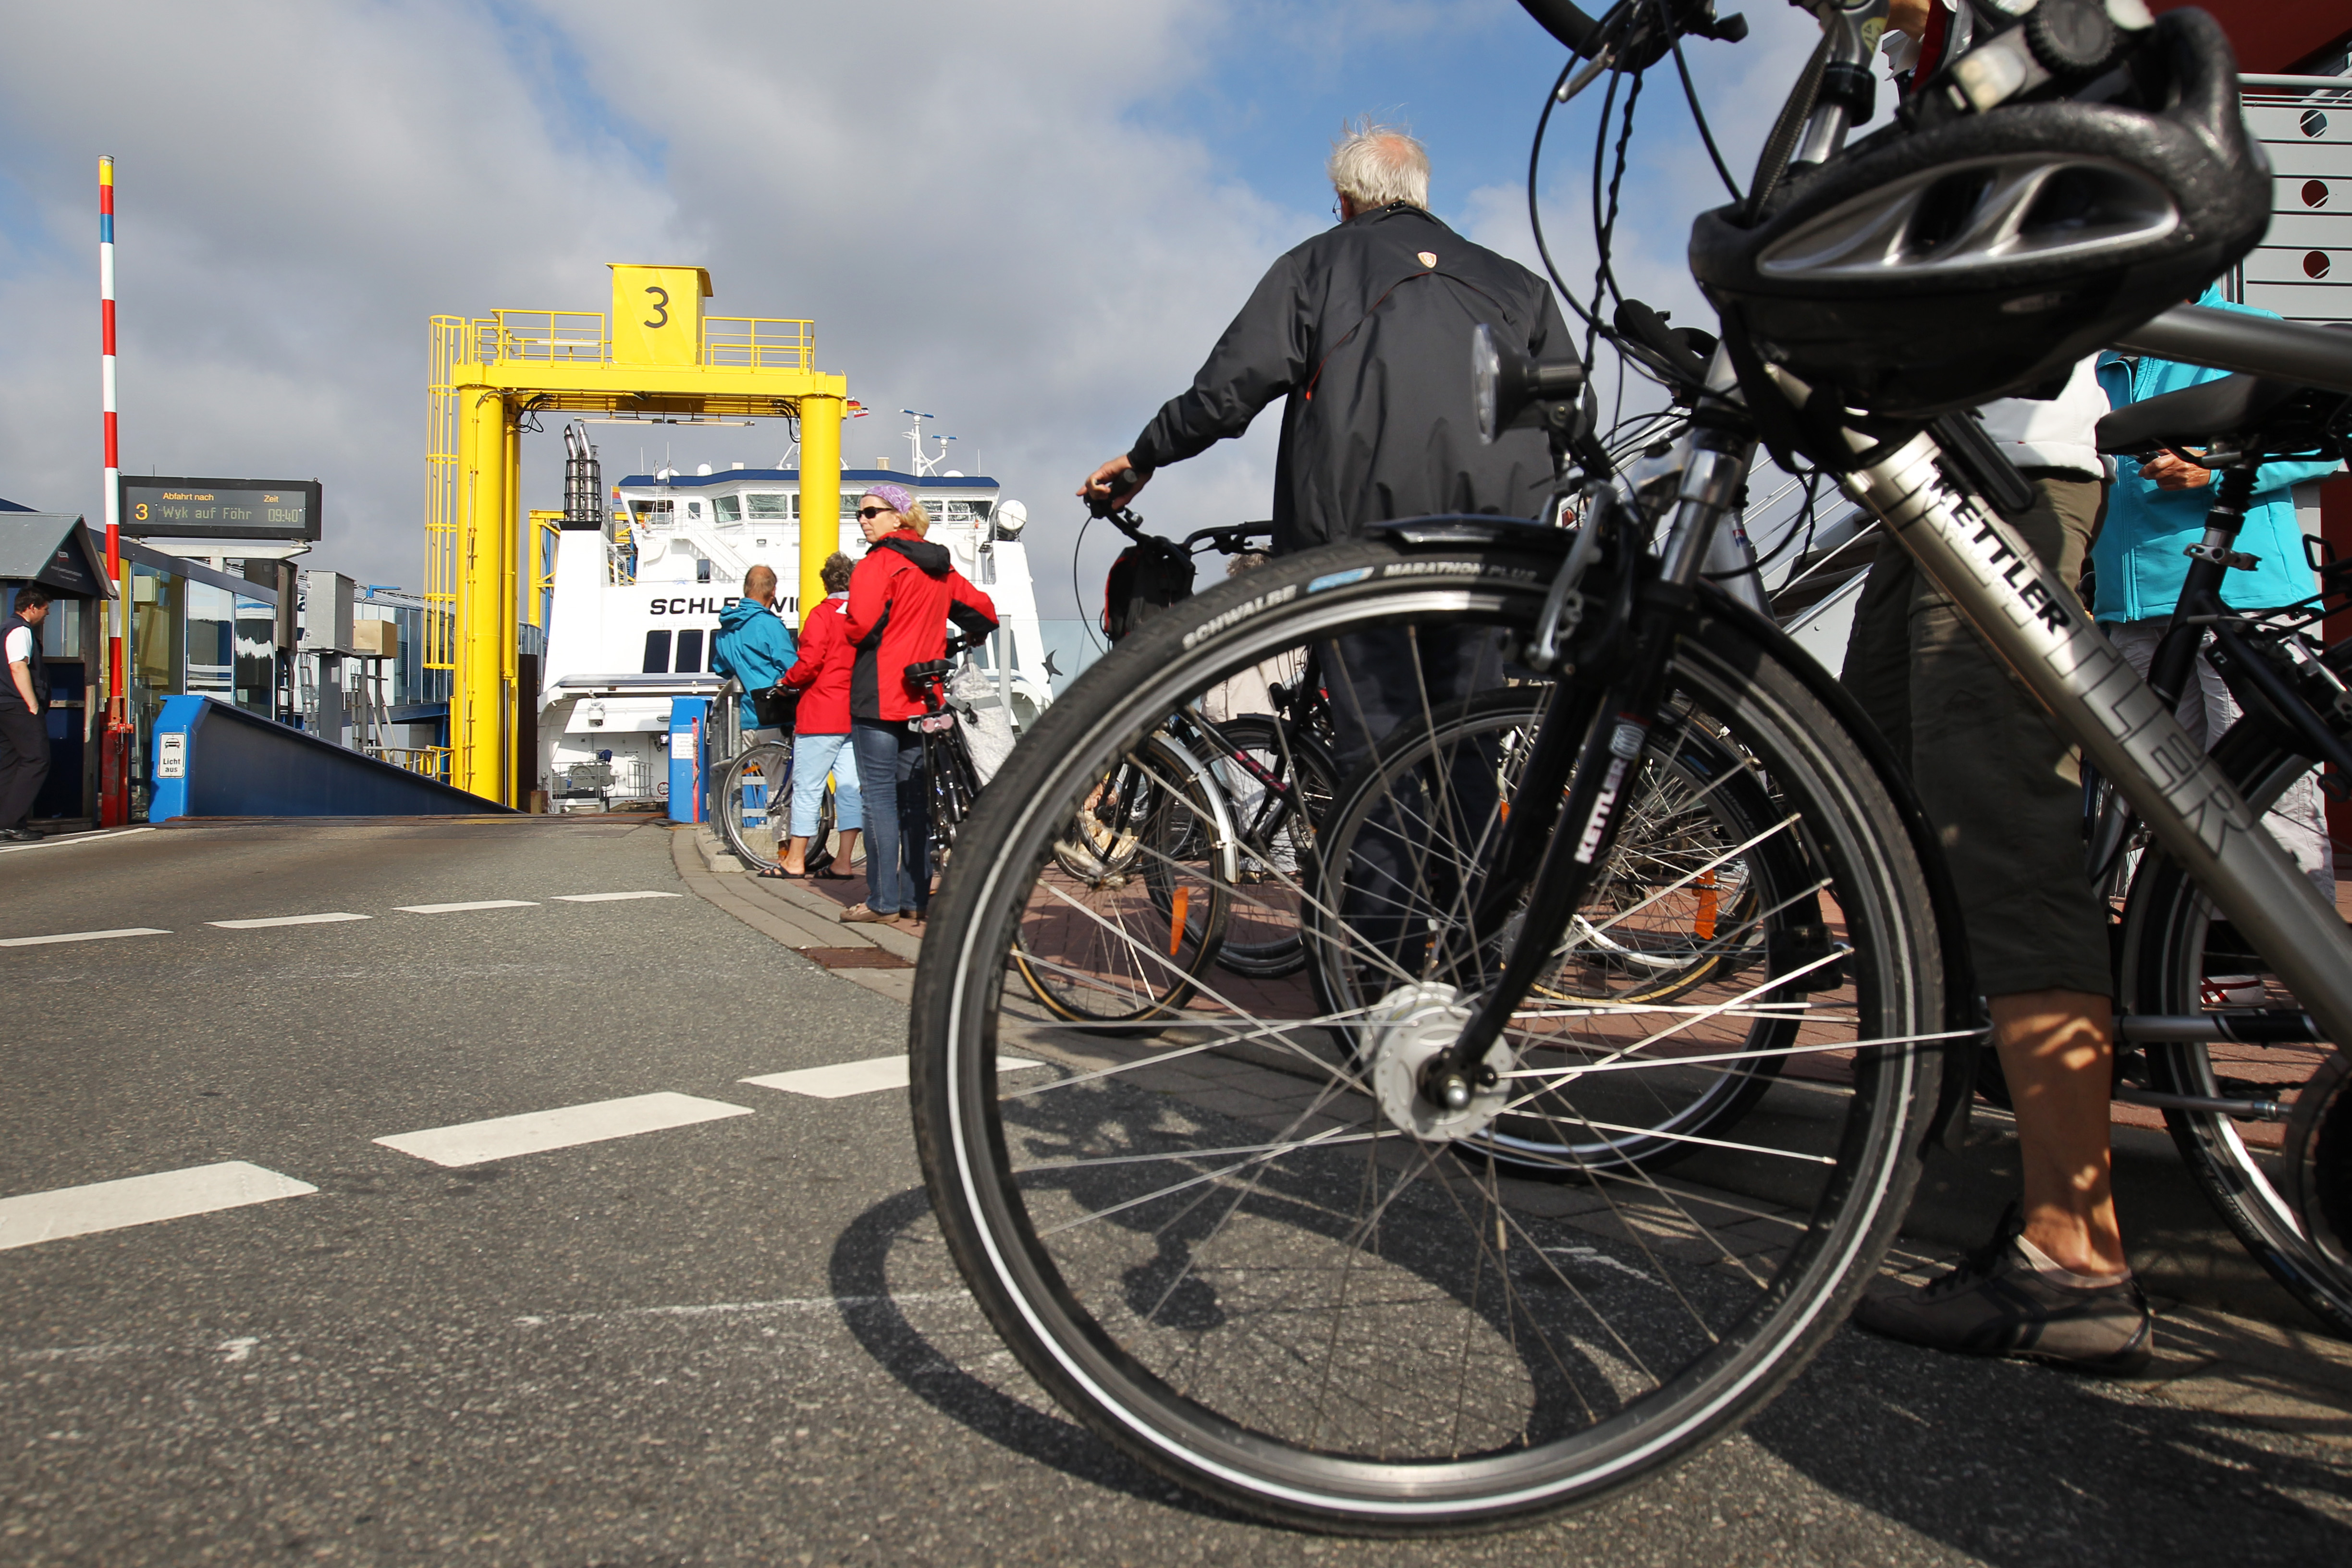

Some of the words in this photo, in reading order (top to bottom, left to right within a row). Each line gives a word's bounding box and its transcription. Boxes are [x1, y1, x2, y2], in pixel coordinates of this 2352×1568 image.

[643, 286, 669, 329] 3
[162, 492, 192, 501] Abfahrt
[194, 493, 214, 502] nach
[263, 494, 279, 503] Zeit
[135, 503, 149, 520] 3
[163, 505, 188, 519] Wyk
[195, 507, 216, 519] auf
[222, 507, 252, 520] Föhr
[267, 508, 299, 523] 09:40
[649, 597, 800, 615] SCHLEWI
[1182, 584, 1298, 651] SCHWALBE
[1573, 756, 1629, 864] KETTLER
